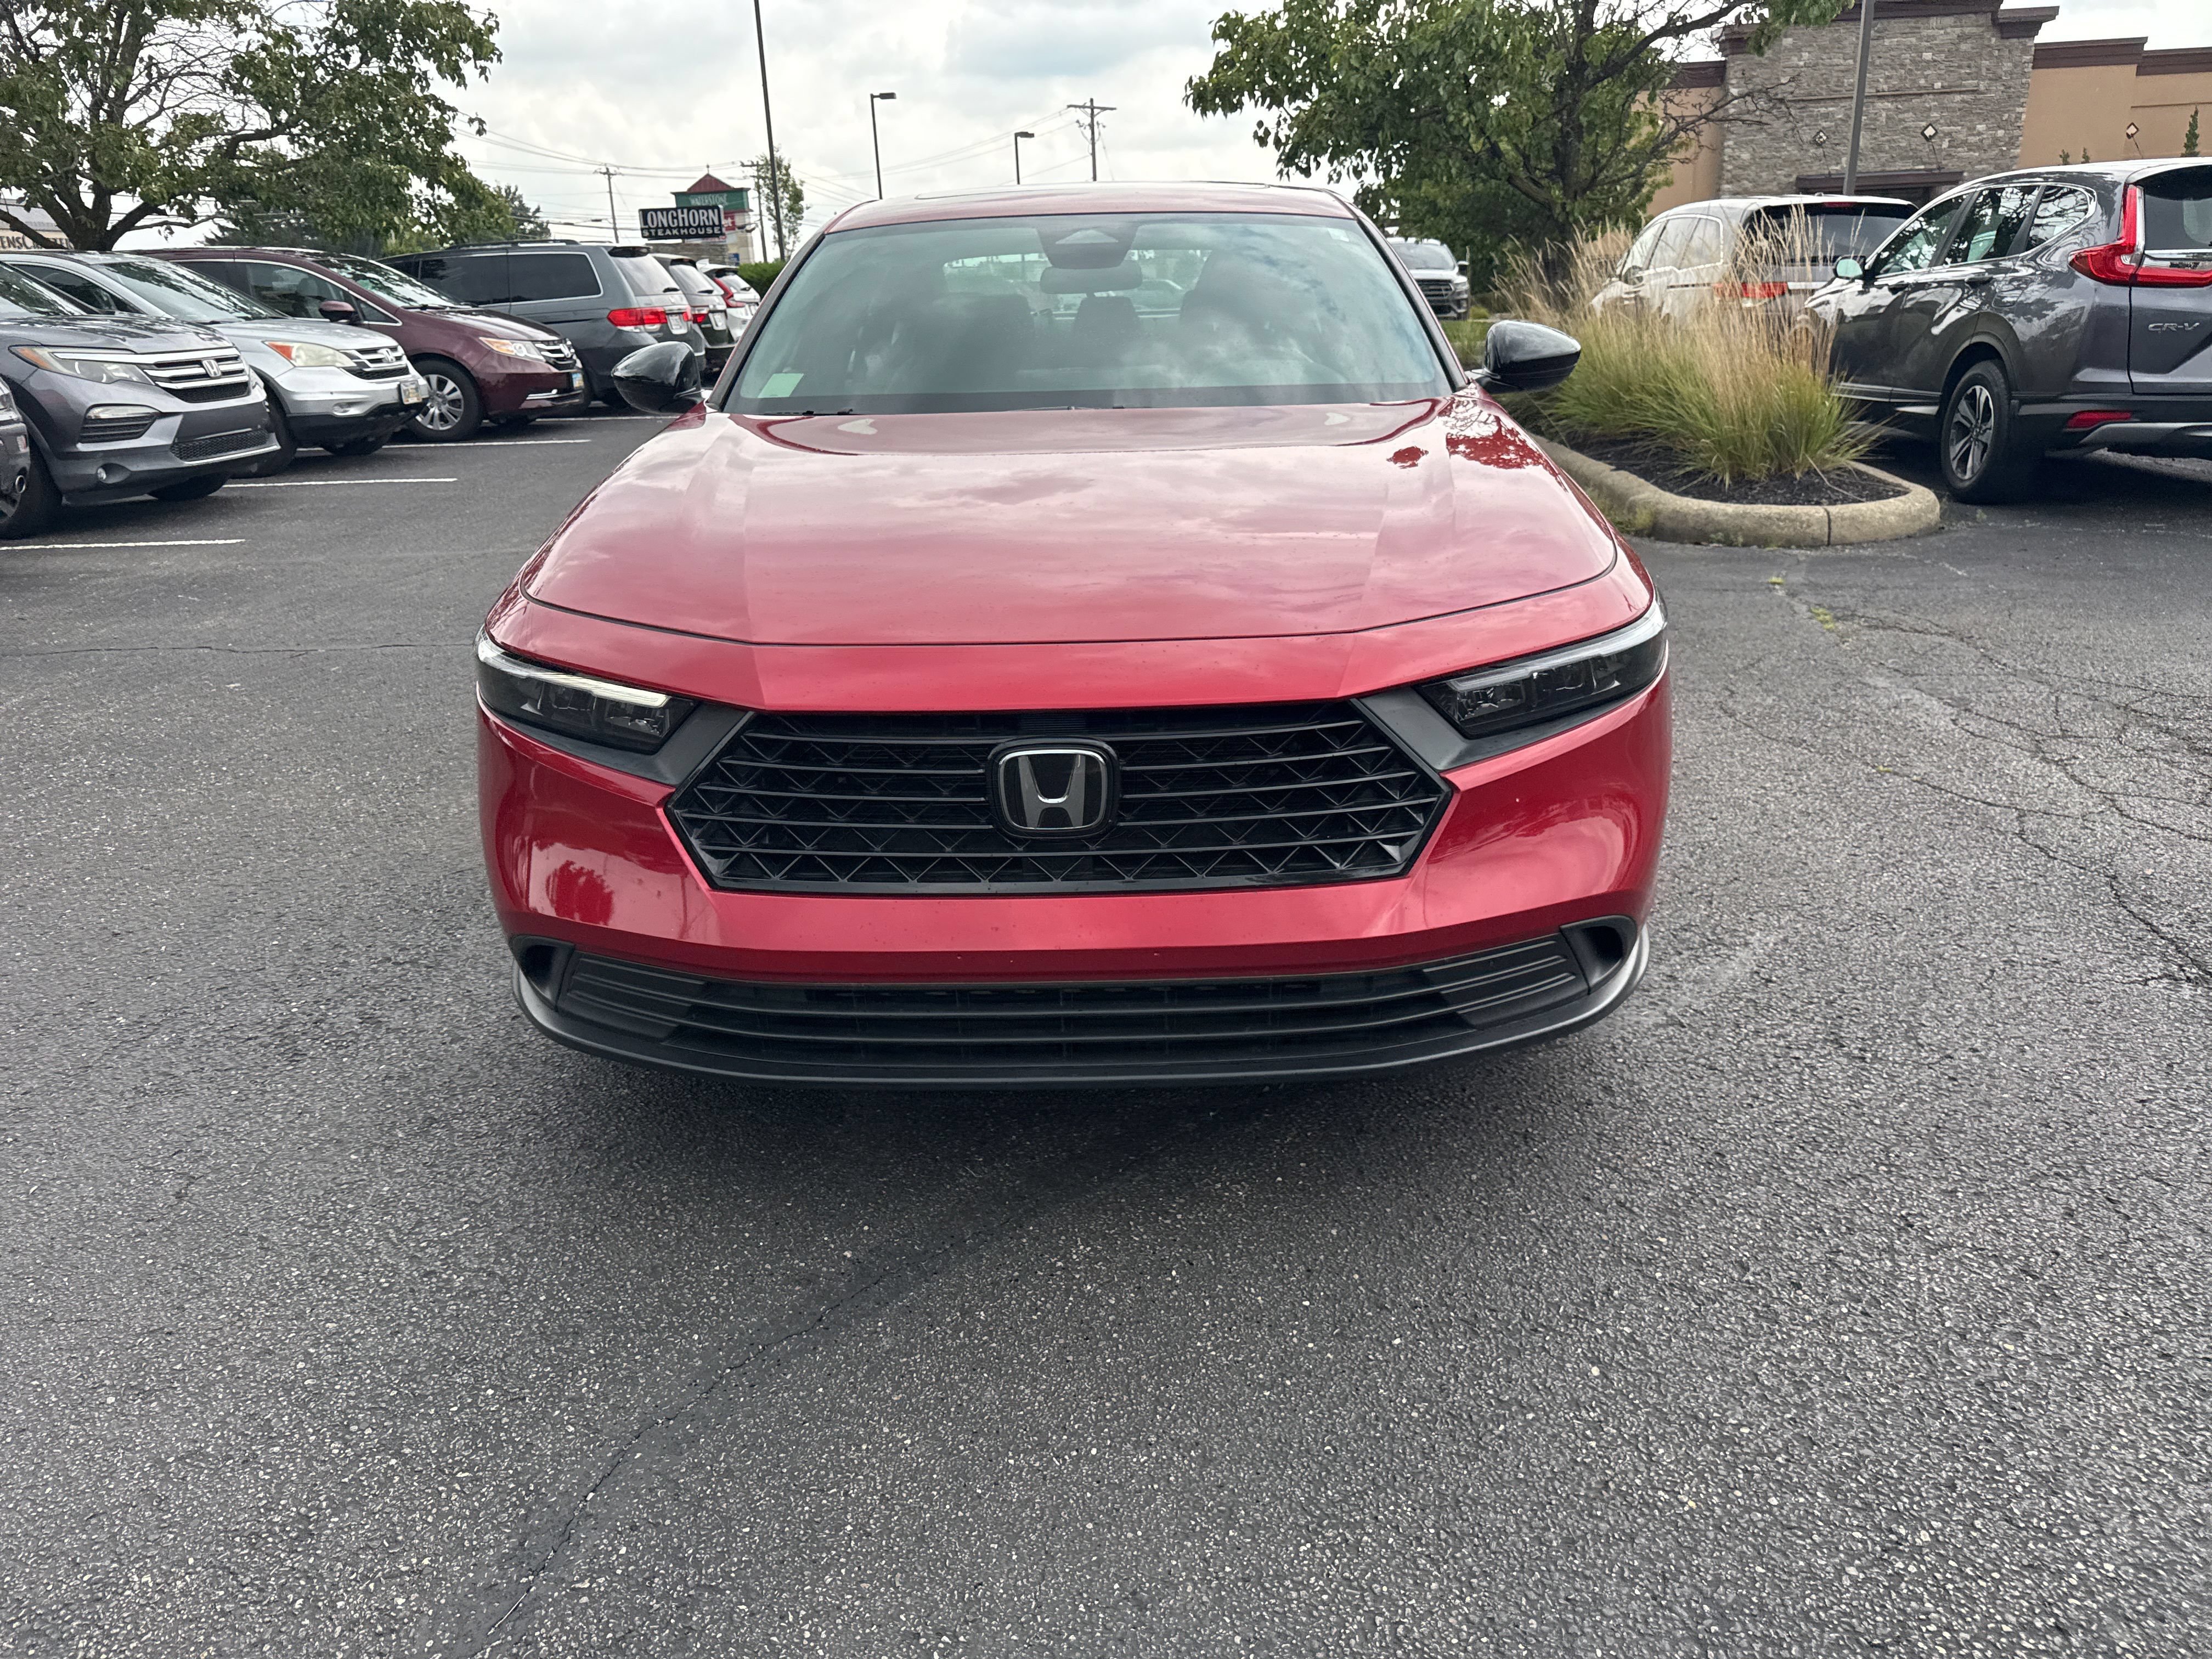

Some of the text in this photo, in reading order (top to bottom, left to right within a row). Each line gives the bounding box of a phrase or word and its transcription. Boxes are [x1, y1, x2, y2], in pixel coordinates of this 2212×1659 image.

[639, 208, 720, 228] LONGHORN
[642, 227, 721, 236] STEAKHOUSE
[2148, 323, 2200, 332] CR-V
